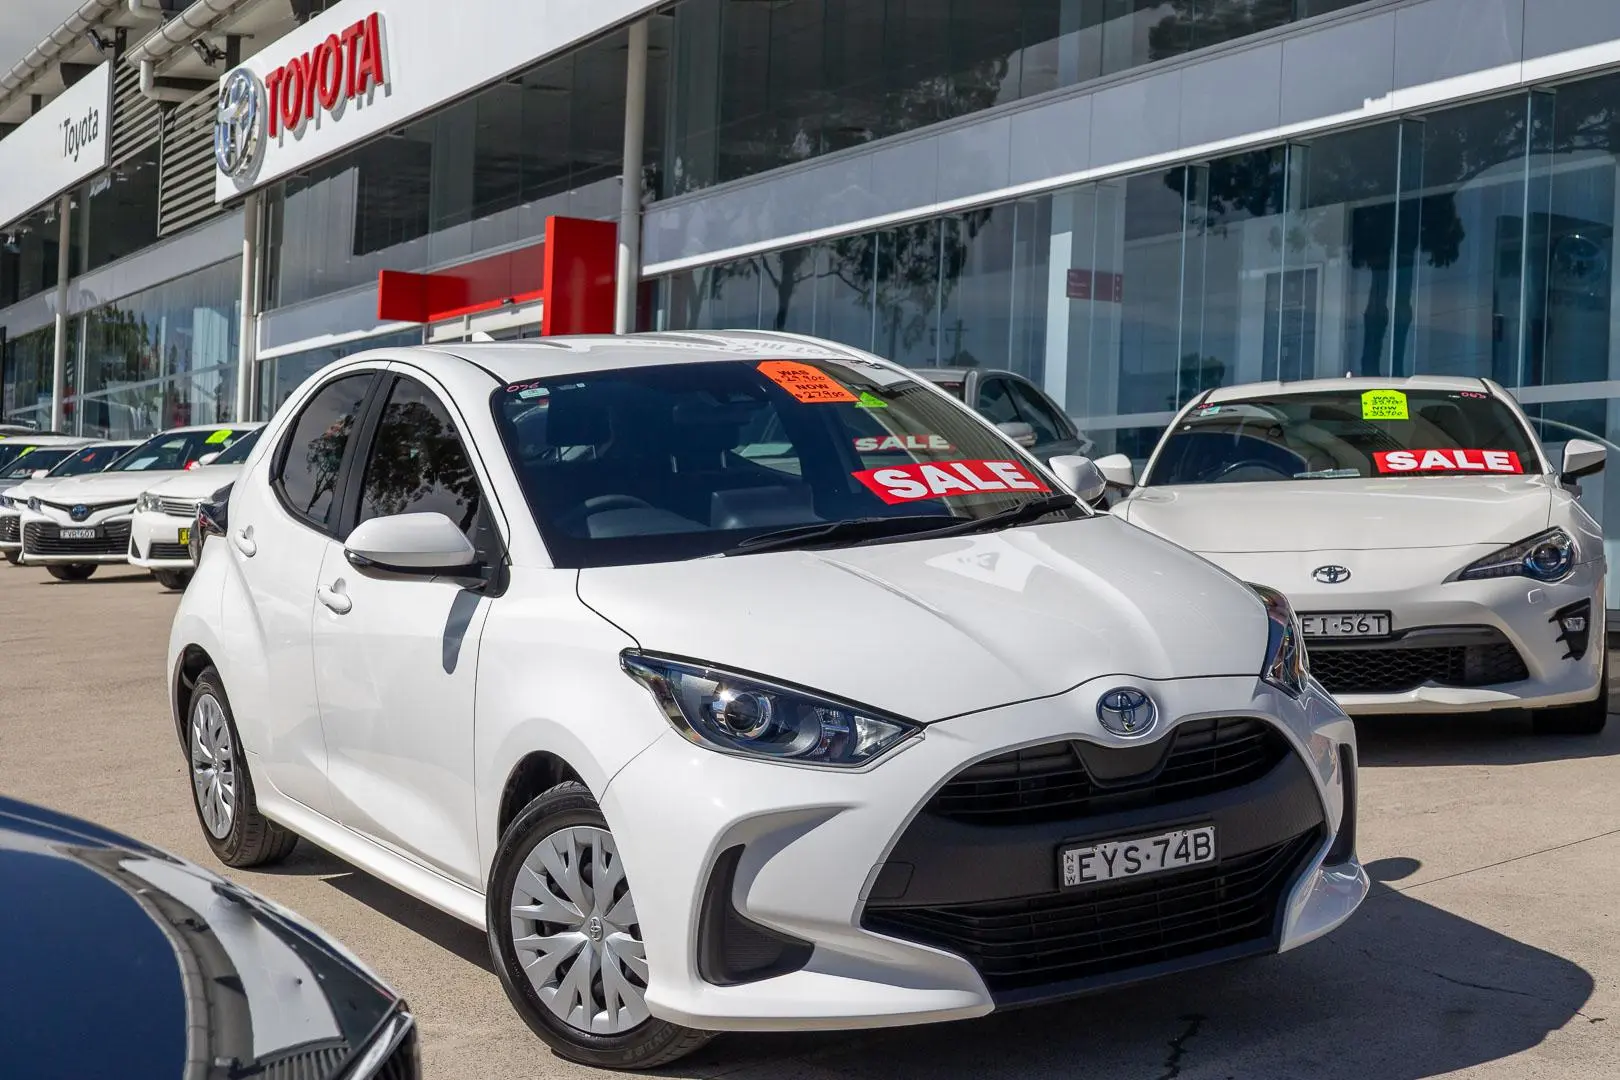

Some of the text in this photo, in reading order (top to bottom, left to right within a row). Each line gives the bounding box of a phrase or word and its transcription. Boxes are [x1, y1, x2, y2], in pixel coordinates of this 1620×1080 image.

[265, 11, 385, 139] TOYOTA
[64, 106, 99, 163] Toyota
[873, 461, 1040, 499] SALE
[1385, 450, 1515, 472] SALE
